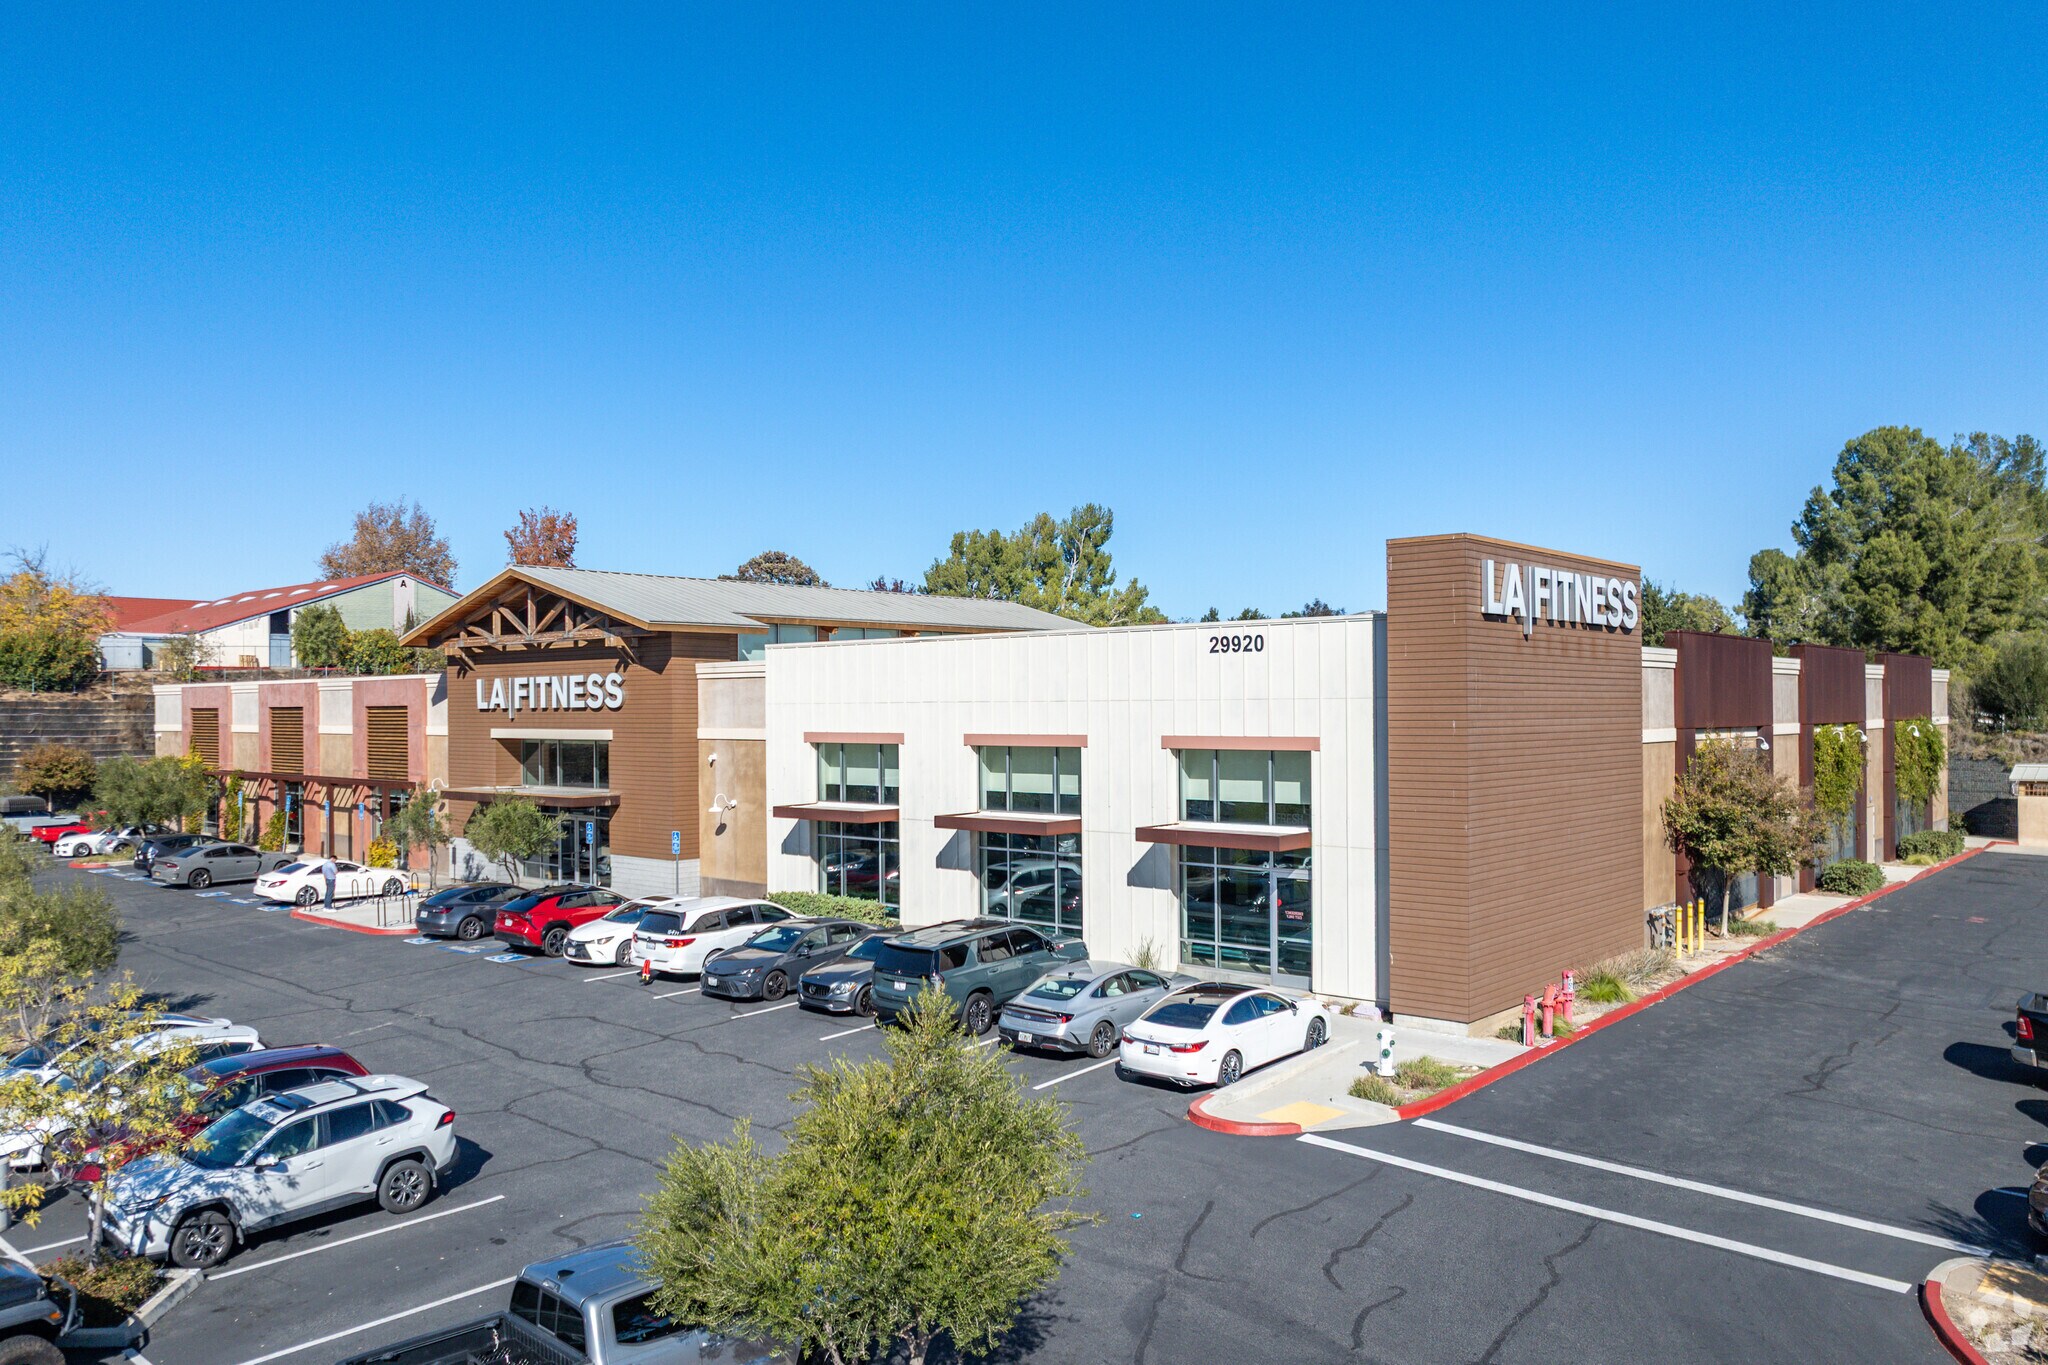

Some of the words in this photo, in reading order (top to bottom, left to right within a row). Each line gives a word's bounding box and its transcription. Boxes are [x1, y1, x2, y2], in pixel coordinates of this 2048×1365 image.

[1481, 559, 1527, 617] LA
[1532, 566, 1638, 629] FITNESS
[1209, 634, 1264, 653] 29920
[476, 677, 506, 709] LA
[514, 672, 623, 709] FITNESS
